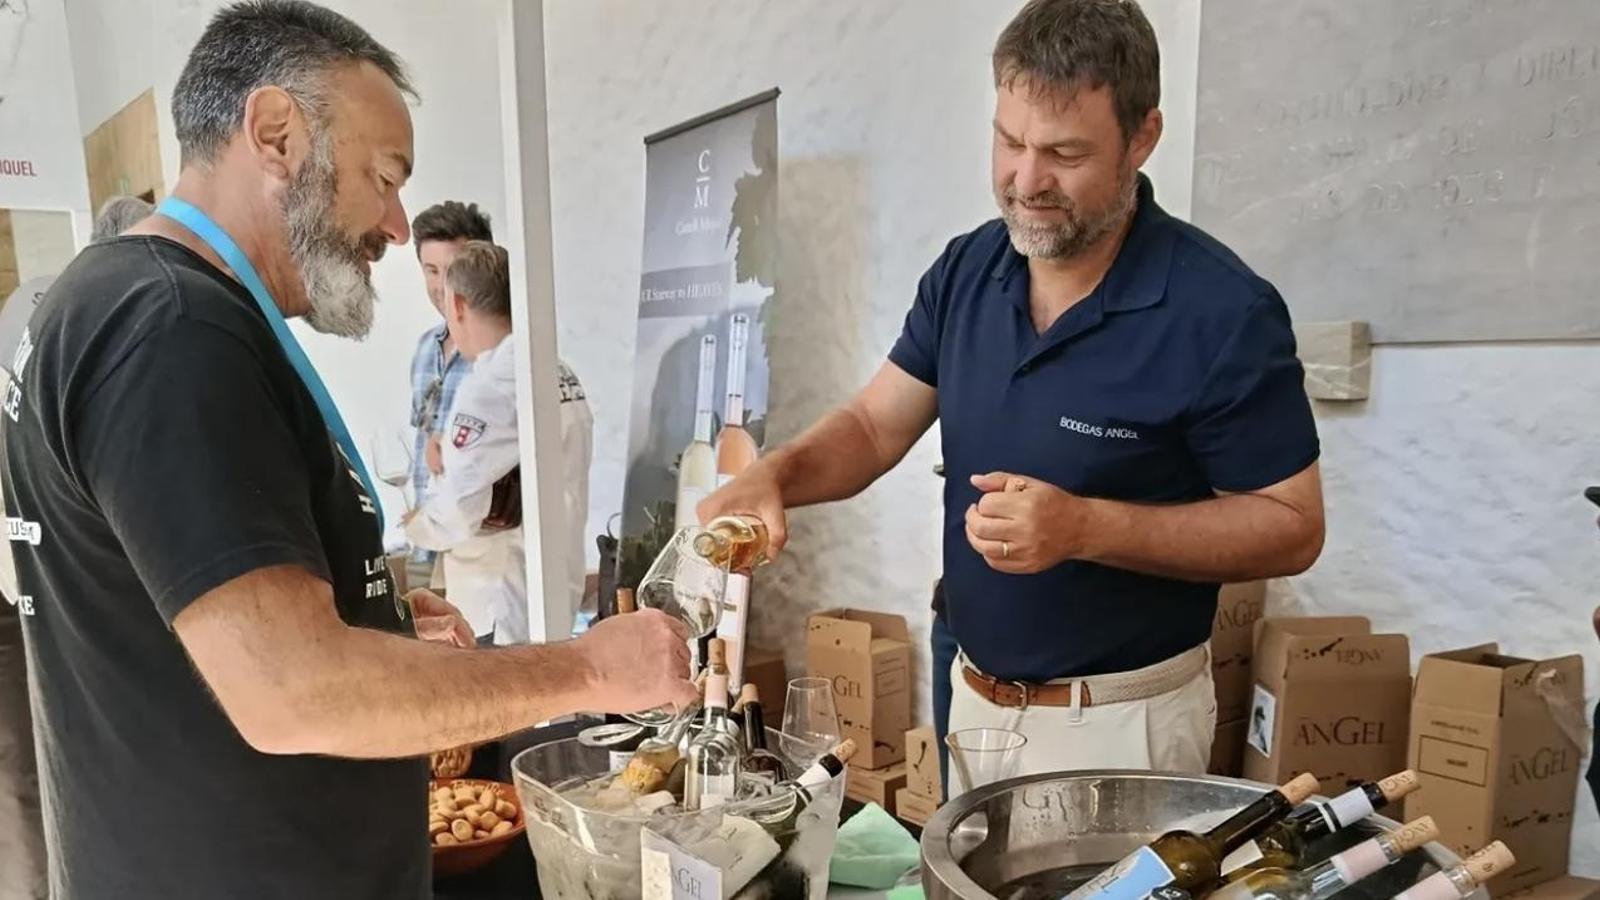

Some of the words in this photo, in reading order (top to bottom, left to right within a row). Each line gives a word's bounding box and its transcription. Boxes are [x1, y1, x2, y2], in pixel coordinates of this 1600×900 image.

[698, 149, 711, 173] C
[693, 184, 710, 209] M
[1060, 416, 1103, 437] BODEGAS
[365, 578, 388, 599] RIDE
